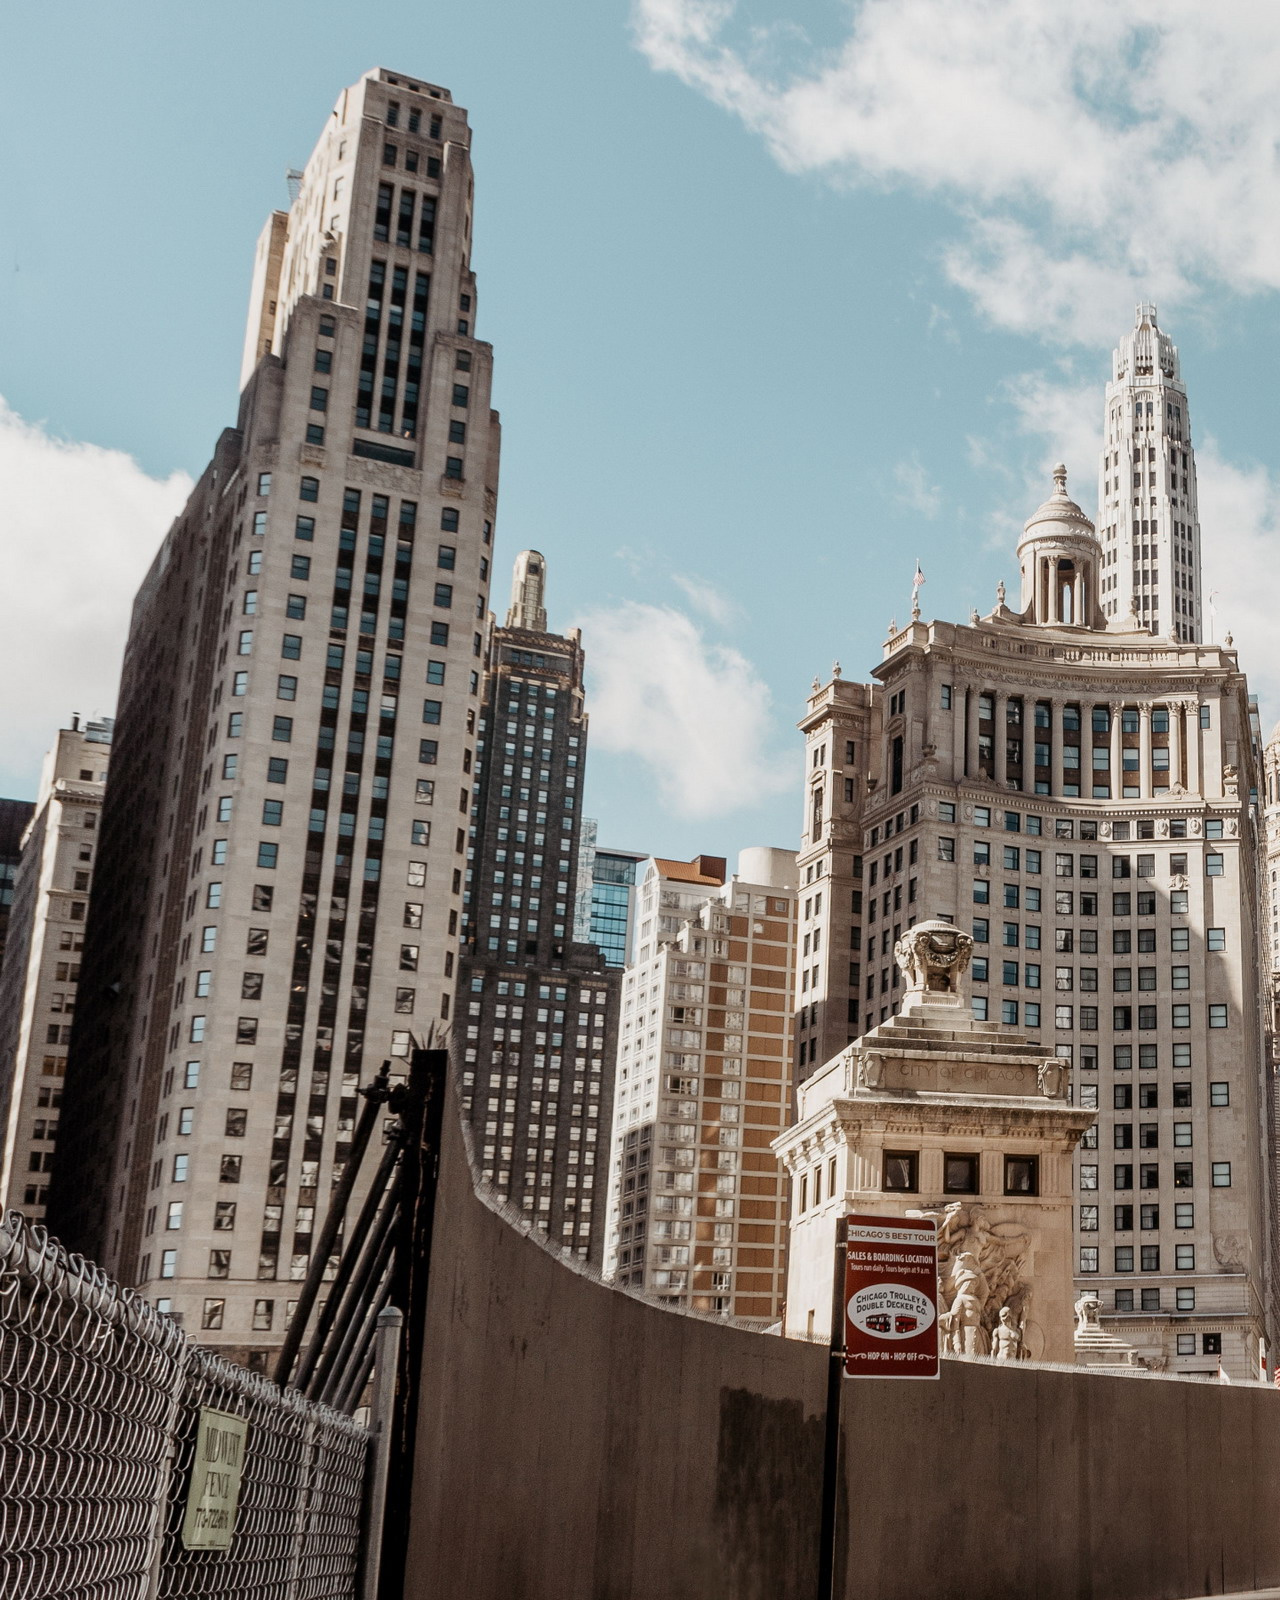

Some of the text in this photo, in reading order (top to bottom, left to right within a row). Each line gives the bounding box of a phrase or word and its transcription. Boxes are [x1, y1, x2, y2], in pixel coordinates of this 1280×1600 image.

[900, 1064, 1025, 1081] CITY OF CHICAGO
[848, 1229, 936, 1242] CHICAGO'S BEST TOUR
[848, 1251, 933, 1264] SALES & BOARDING LOCATION
[851, 1263, 864, 1271] Tours
[885, 1264, 897, 1273] Tours
[898, 1265, 911, 1275] begin
[856, 1291, 927, 1307] CHICAGO TROLLEY &
[856, 1301, 884, 1313] DOUBLE
[886, 1300, 914, 1311] DECKER
[867, 1352, 879, 1360] HOP
[893, 1352, 906, 1360] HOP
[906, 1352, 918, 1360] OFF
